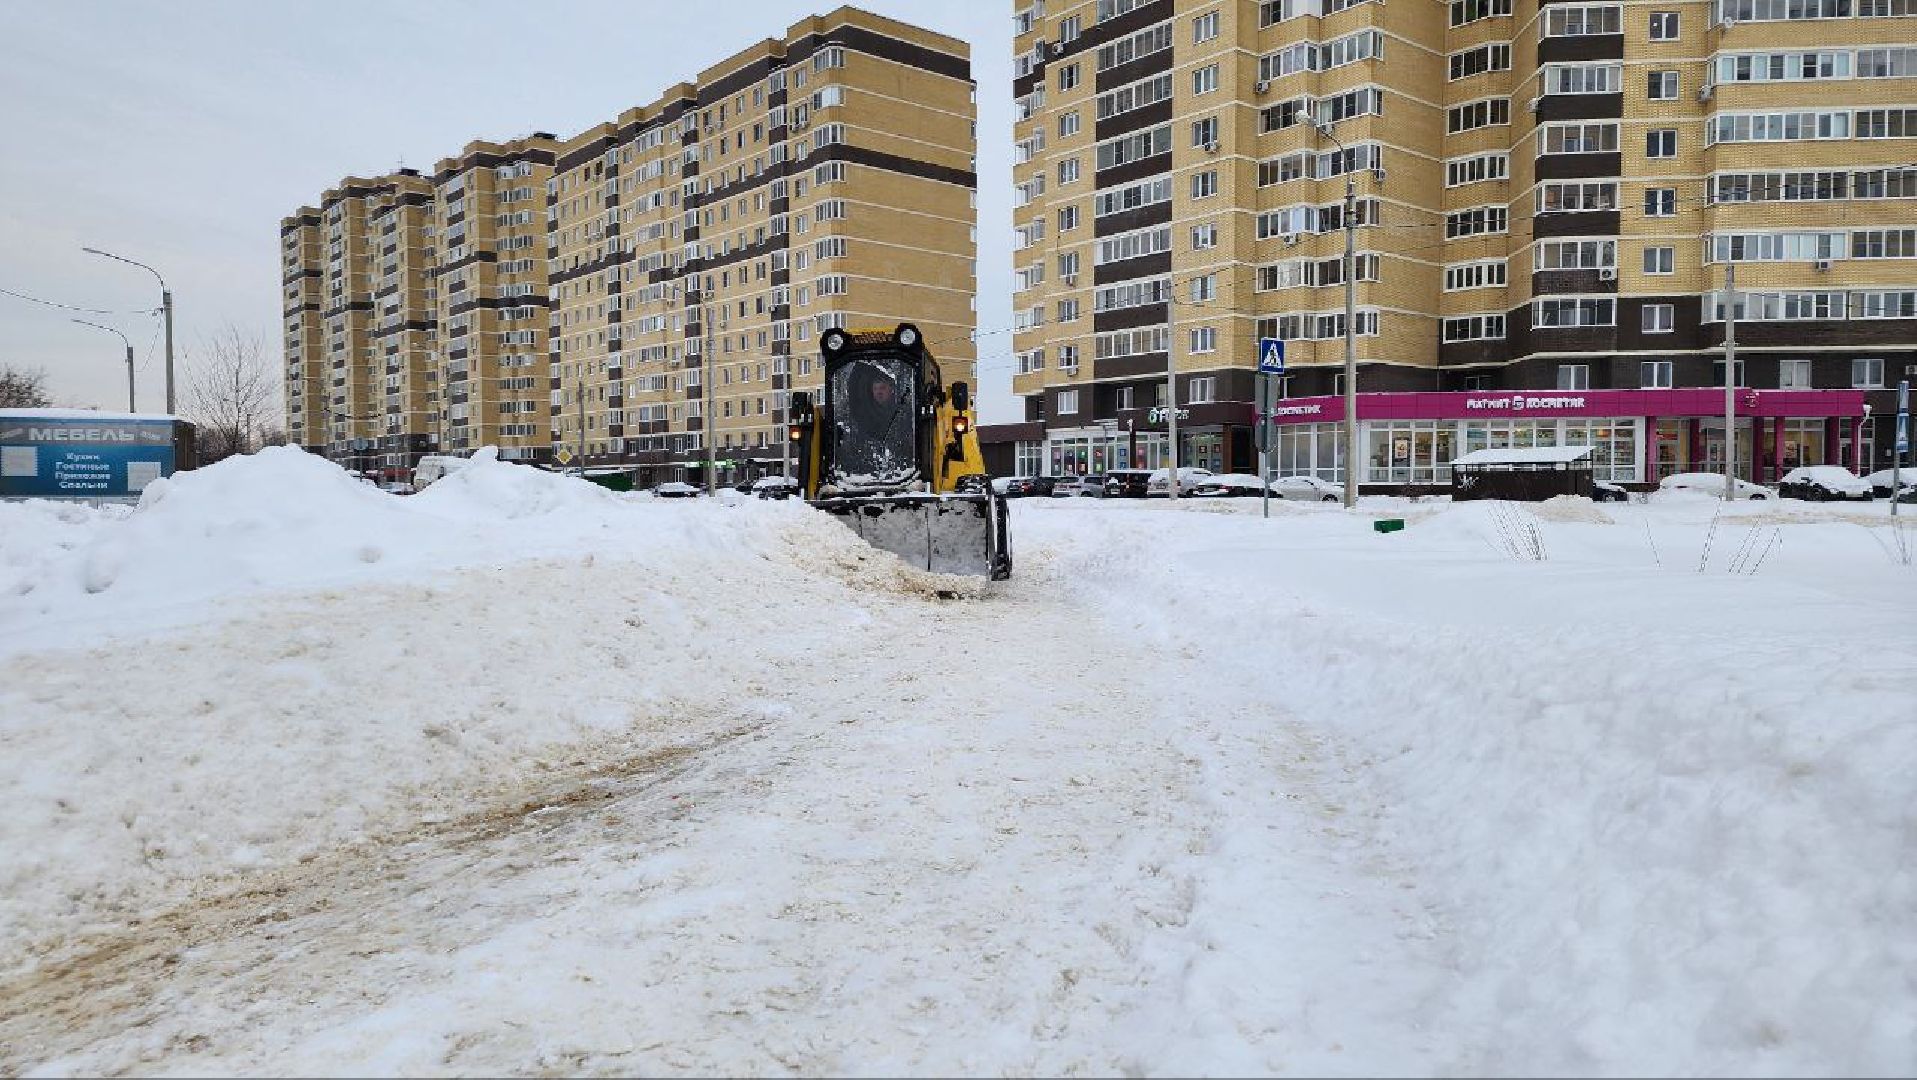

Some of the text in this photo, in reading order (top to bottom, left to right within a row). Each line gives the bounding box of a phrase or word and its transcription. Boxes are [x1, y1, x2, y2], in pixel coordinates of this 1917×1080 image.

[1467, 397, 1585, 409] МАГНИТ КОСМЕТИК
[28, 427, 135, 441] МЕБЕЛЬ
[66, 452, 100, 462] Кухни
[55, 461, 110, 470] Гостиные
[55, 471, 111, 480] Прихожие
[59, 481, 108, 489] Спальни
